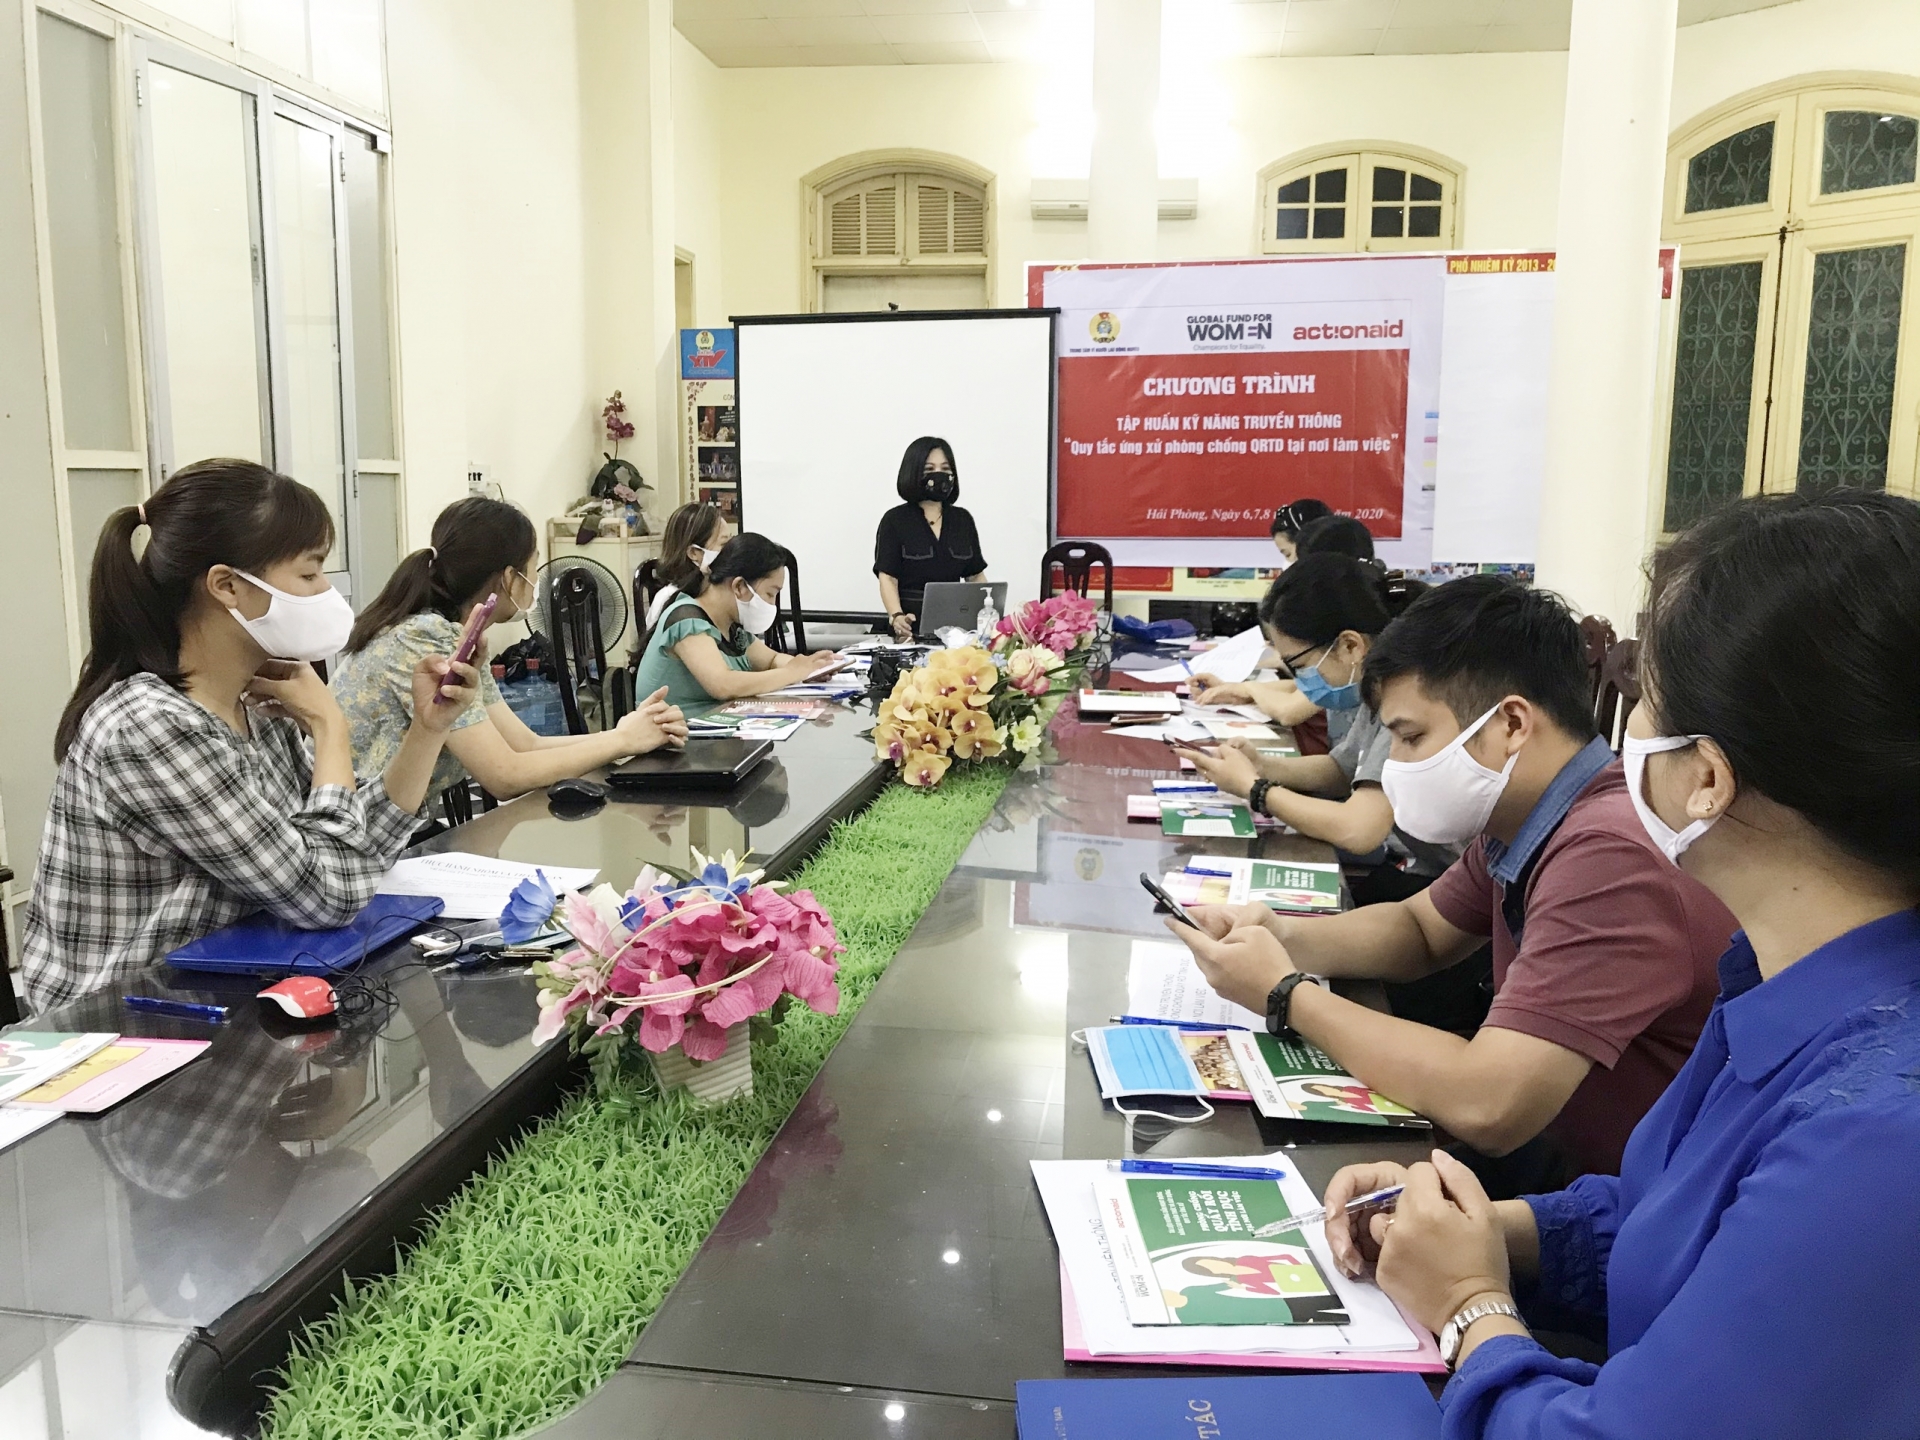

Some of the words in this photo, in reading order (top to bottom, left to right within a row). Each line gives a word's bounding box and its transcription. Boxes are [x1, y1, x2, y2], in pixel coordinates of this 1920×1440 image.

[1516, 259, 1539, 272] 2013
[1187, 315, 1223, 324] GLOBAL
[1227, 314, 1252, 323] FUND
[1253, 313, 1272, 322] FOR
[1143, 376, 1236, 396] CHƯƠNG
[1242, 371, 1316, 395] TRÌNH
[1117, 414, 1140, 434] TẬP
[1144, 411, 1179, 431] HUẤN
[1182, 413, 1199, 430] KỸ
[1203, 412, 1240, 430] NĂNG
[1243, 410, 1294, 429] TRUYỀN
[1298, 411, 1342, 429] THÔNG
[1096, 437, 1116, 454] tắc
[1119, 438, 1142, 455] ứng
[1145, 438, 1162, 454] xử
[1164, 438, 1204, 455] phòng
[1207, 436, 1247, 454] chống
[1250, 438, 1284, 454] QRTD
[1287, 438, 1305, 455] tại
[1308, 438, 1329, 452] nơi
[1333, 437, 1358, 452] làm
[1211, 508, 1240, 521] Ngày
[1355, 508, 1384, 520] 2020
[1188, 1190, 1202, 1212] CHỐNG
[1197, 1190, 1217, 1206] RỐI
[1216, 1190, 1234, 1210] DỤC
[1195, 1211, 1210, 1231] PHÒNG
[1204, 1207, 1229, 1232] QUẤY
[1223, 1210, 1243, 1232] TÌNH
[1184, 1399, 1221, 1439] TÁC
